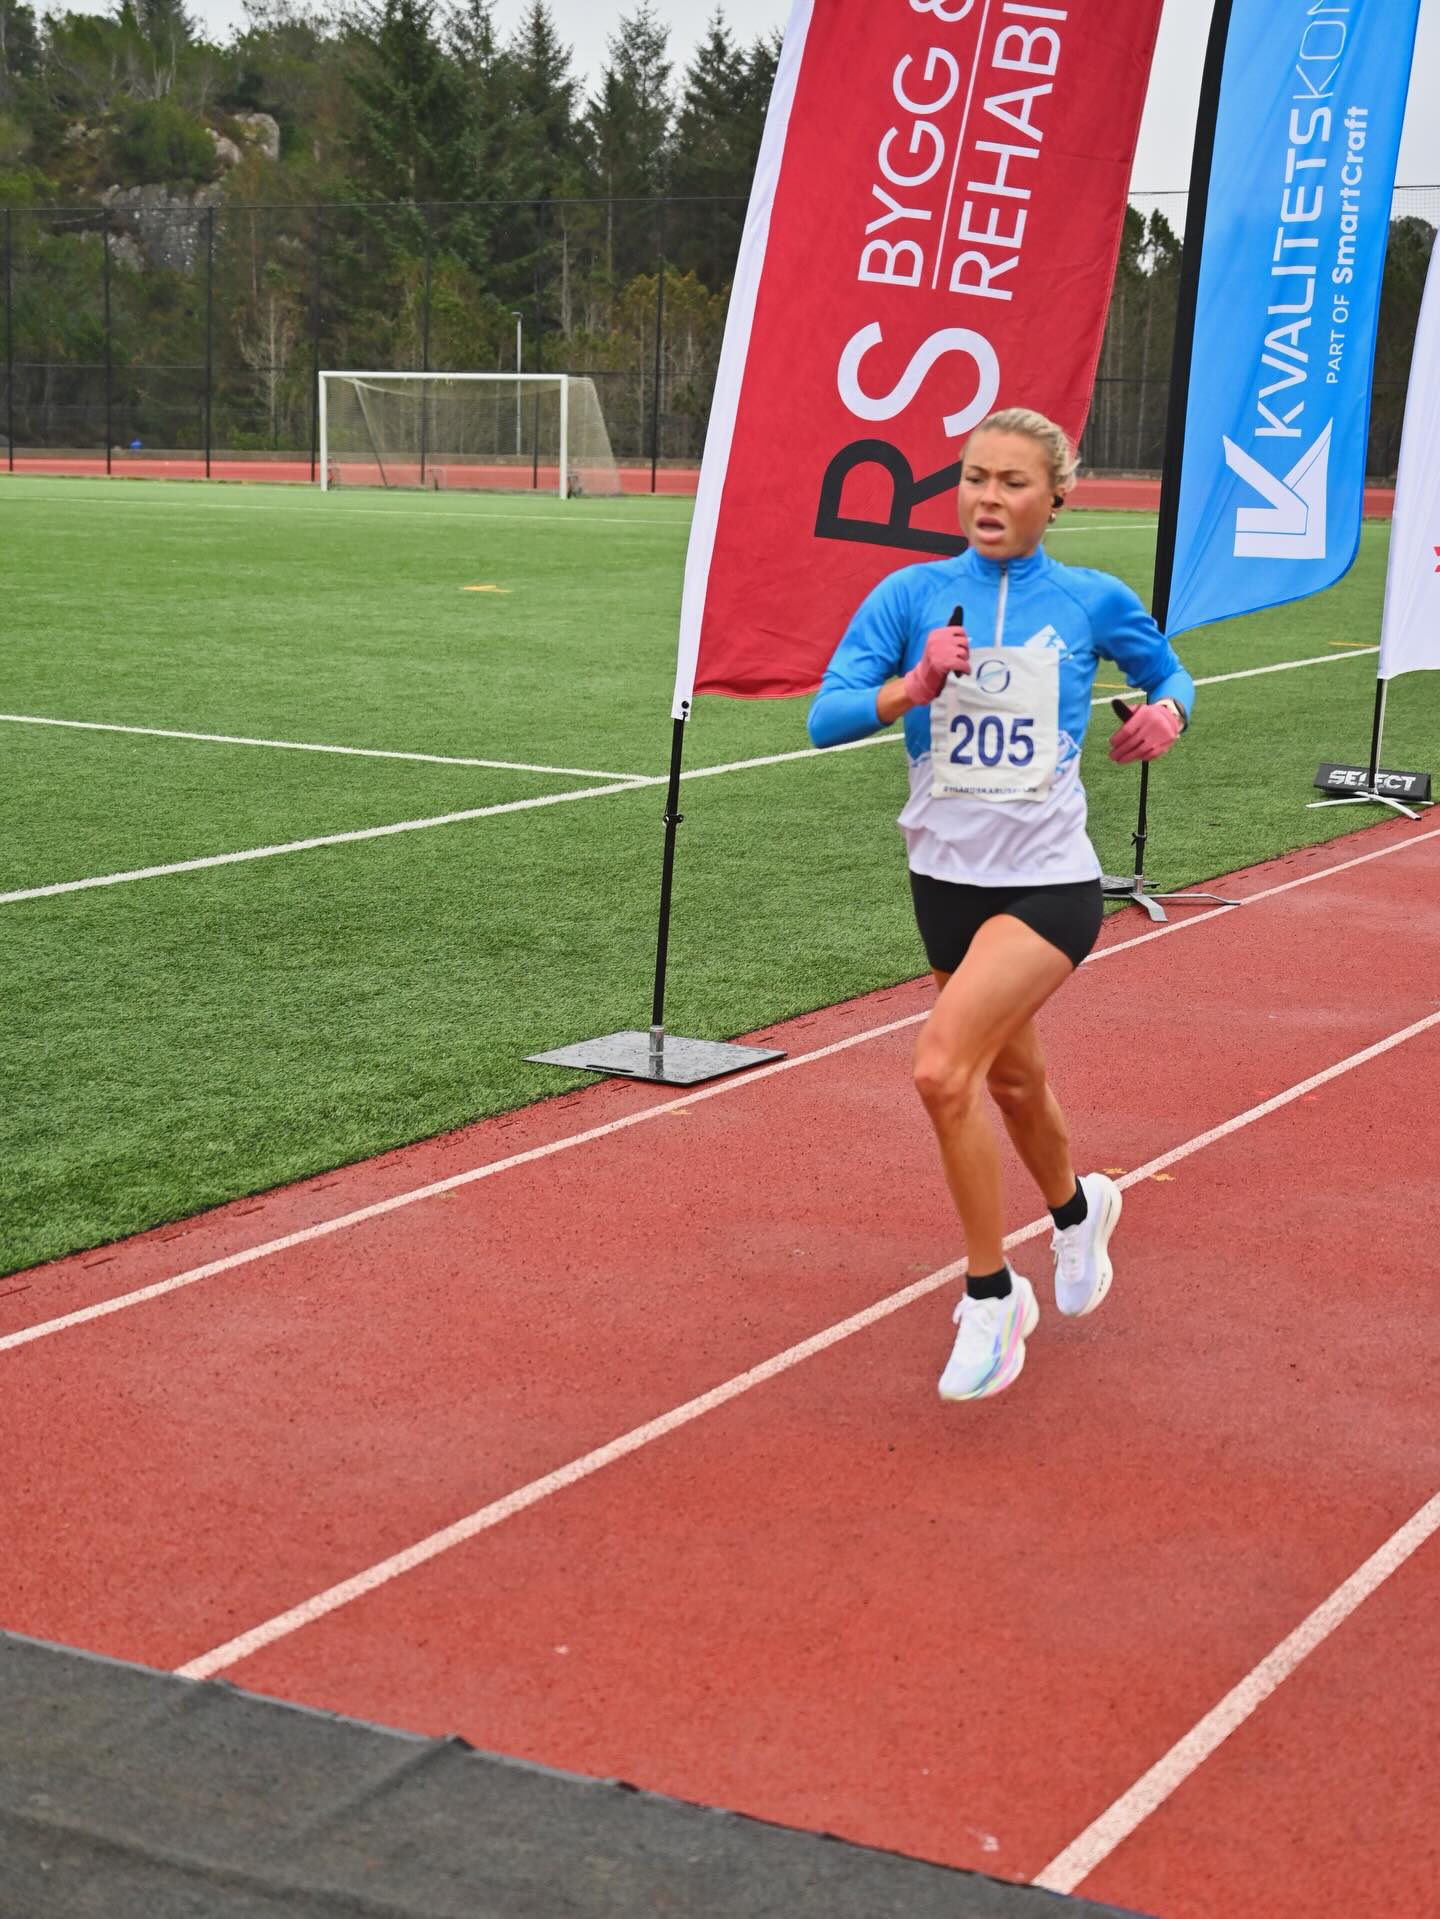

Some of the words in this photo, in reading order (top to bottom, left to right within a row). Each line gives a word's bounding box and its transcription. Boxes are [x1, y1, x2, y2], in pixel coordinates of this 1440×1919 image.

[858, 47, 959, 287] BYGG
[949, 3, 1068, 301] REHABI
[1331, 106, 1369, 285] SmartCraft
[1326, 330, 1345, 384] PART
[1331, 294, 1349, 324] OF
[814, 322, 1000, 557] RS
[950, 714, 1034, 767] 205
